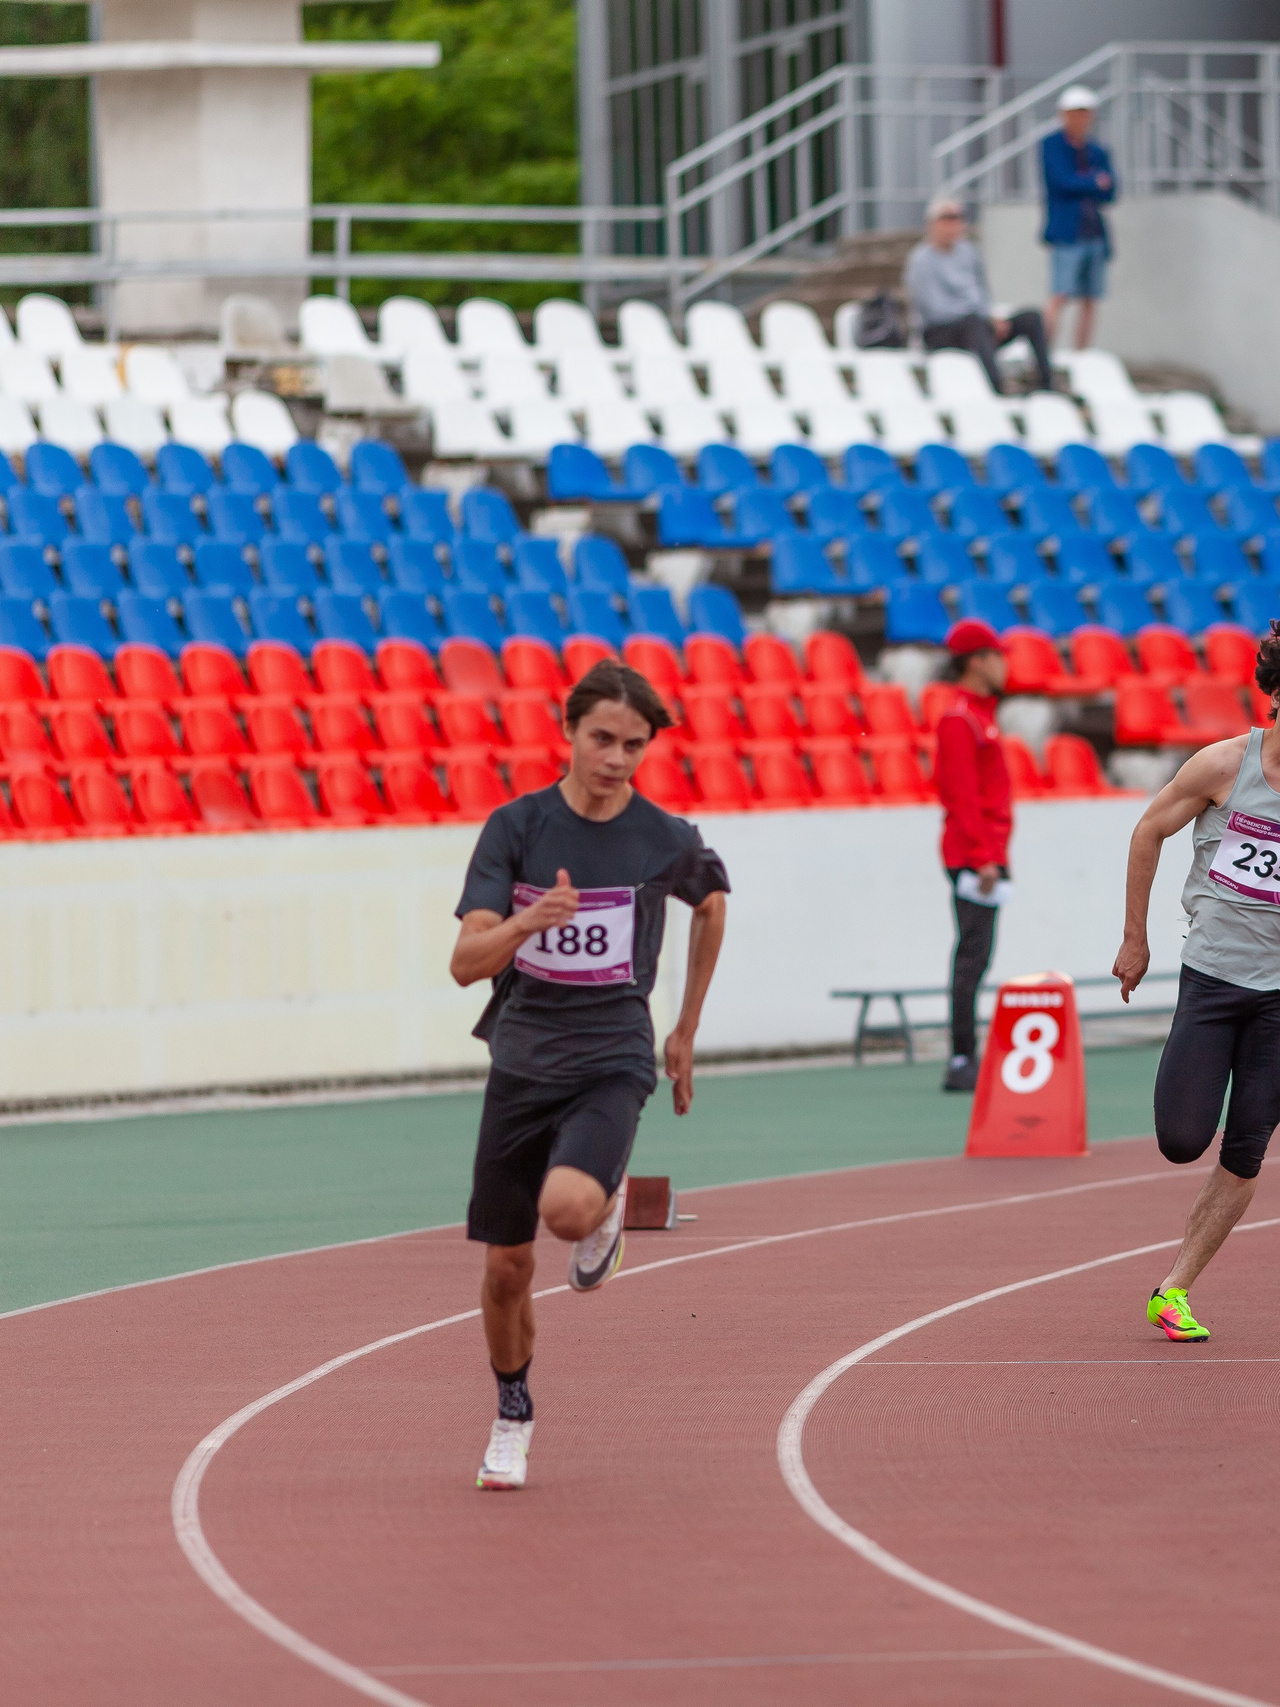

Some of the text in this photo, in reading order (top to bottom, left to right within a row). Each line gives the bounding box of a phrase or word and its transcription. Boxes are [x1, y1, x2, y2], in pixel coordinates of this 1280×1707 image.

[1236, 816, 1272, 831] ПЕРВЕНСТВО
[535, 923, 608, 956] 188
[1001, 1011, 1060, 1094] 8
